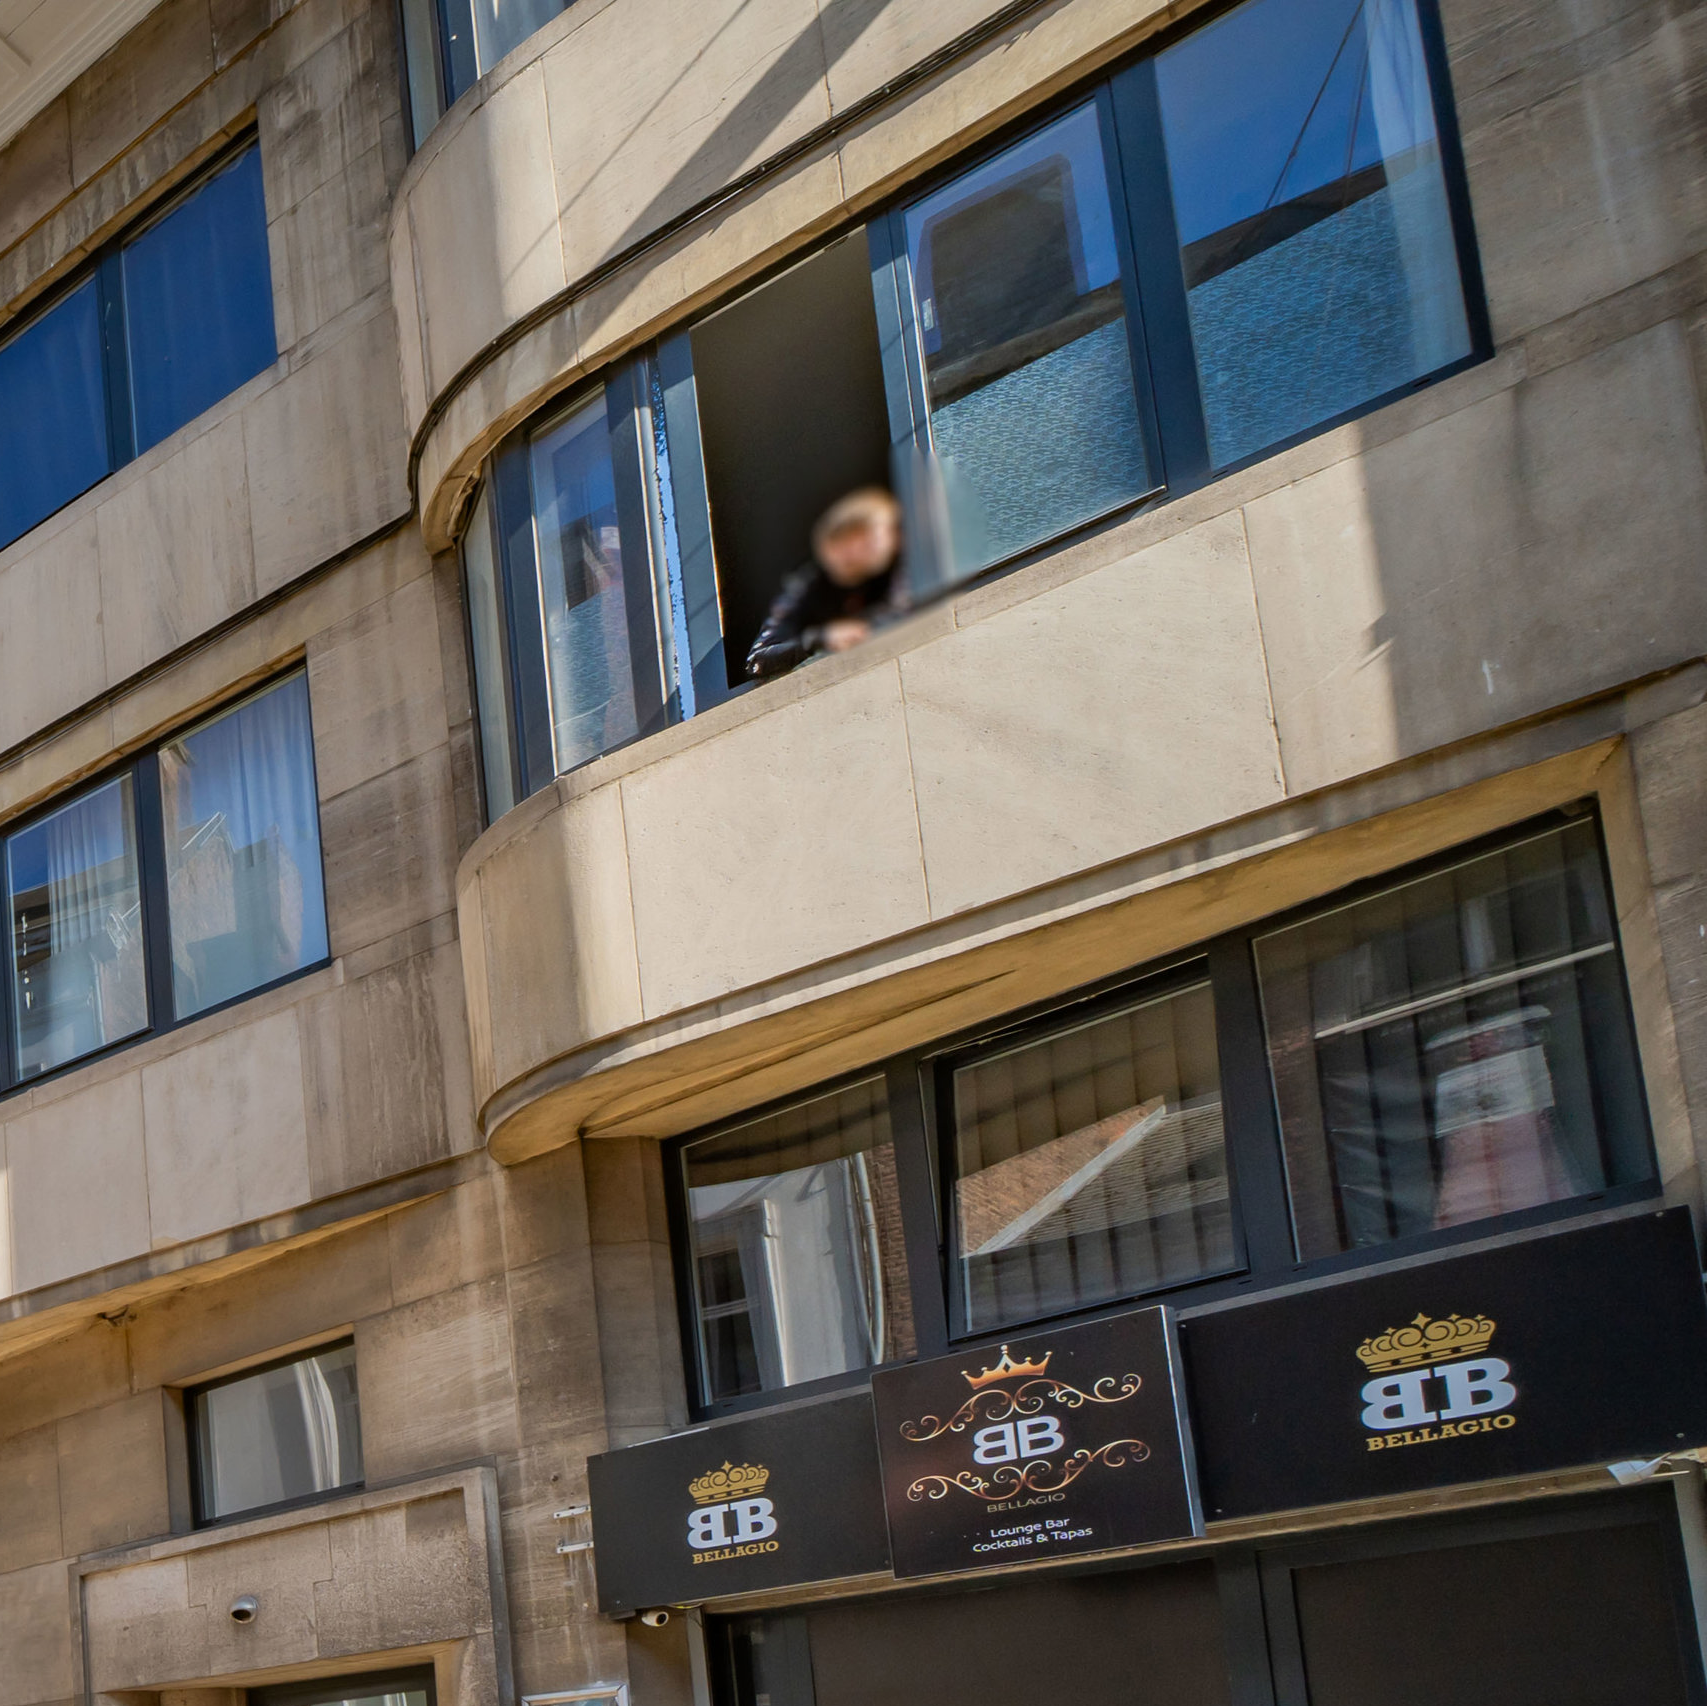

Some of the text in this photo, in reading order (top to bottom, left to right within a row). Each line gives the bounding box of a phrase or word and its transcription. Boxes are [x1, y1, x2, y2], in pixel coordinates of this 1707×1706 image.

[1365, 1414, 1517, 1452] BELLAGIO
[986, 1492, 1066, 1513] BELLAGIO
[972, 1527, 1094, 1553] Cocktails & Tapas
[990, 1517, 1071, 1539] Lounge Bar
[692, 1541, 780, 1565] BELLAGIO
